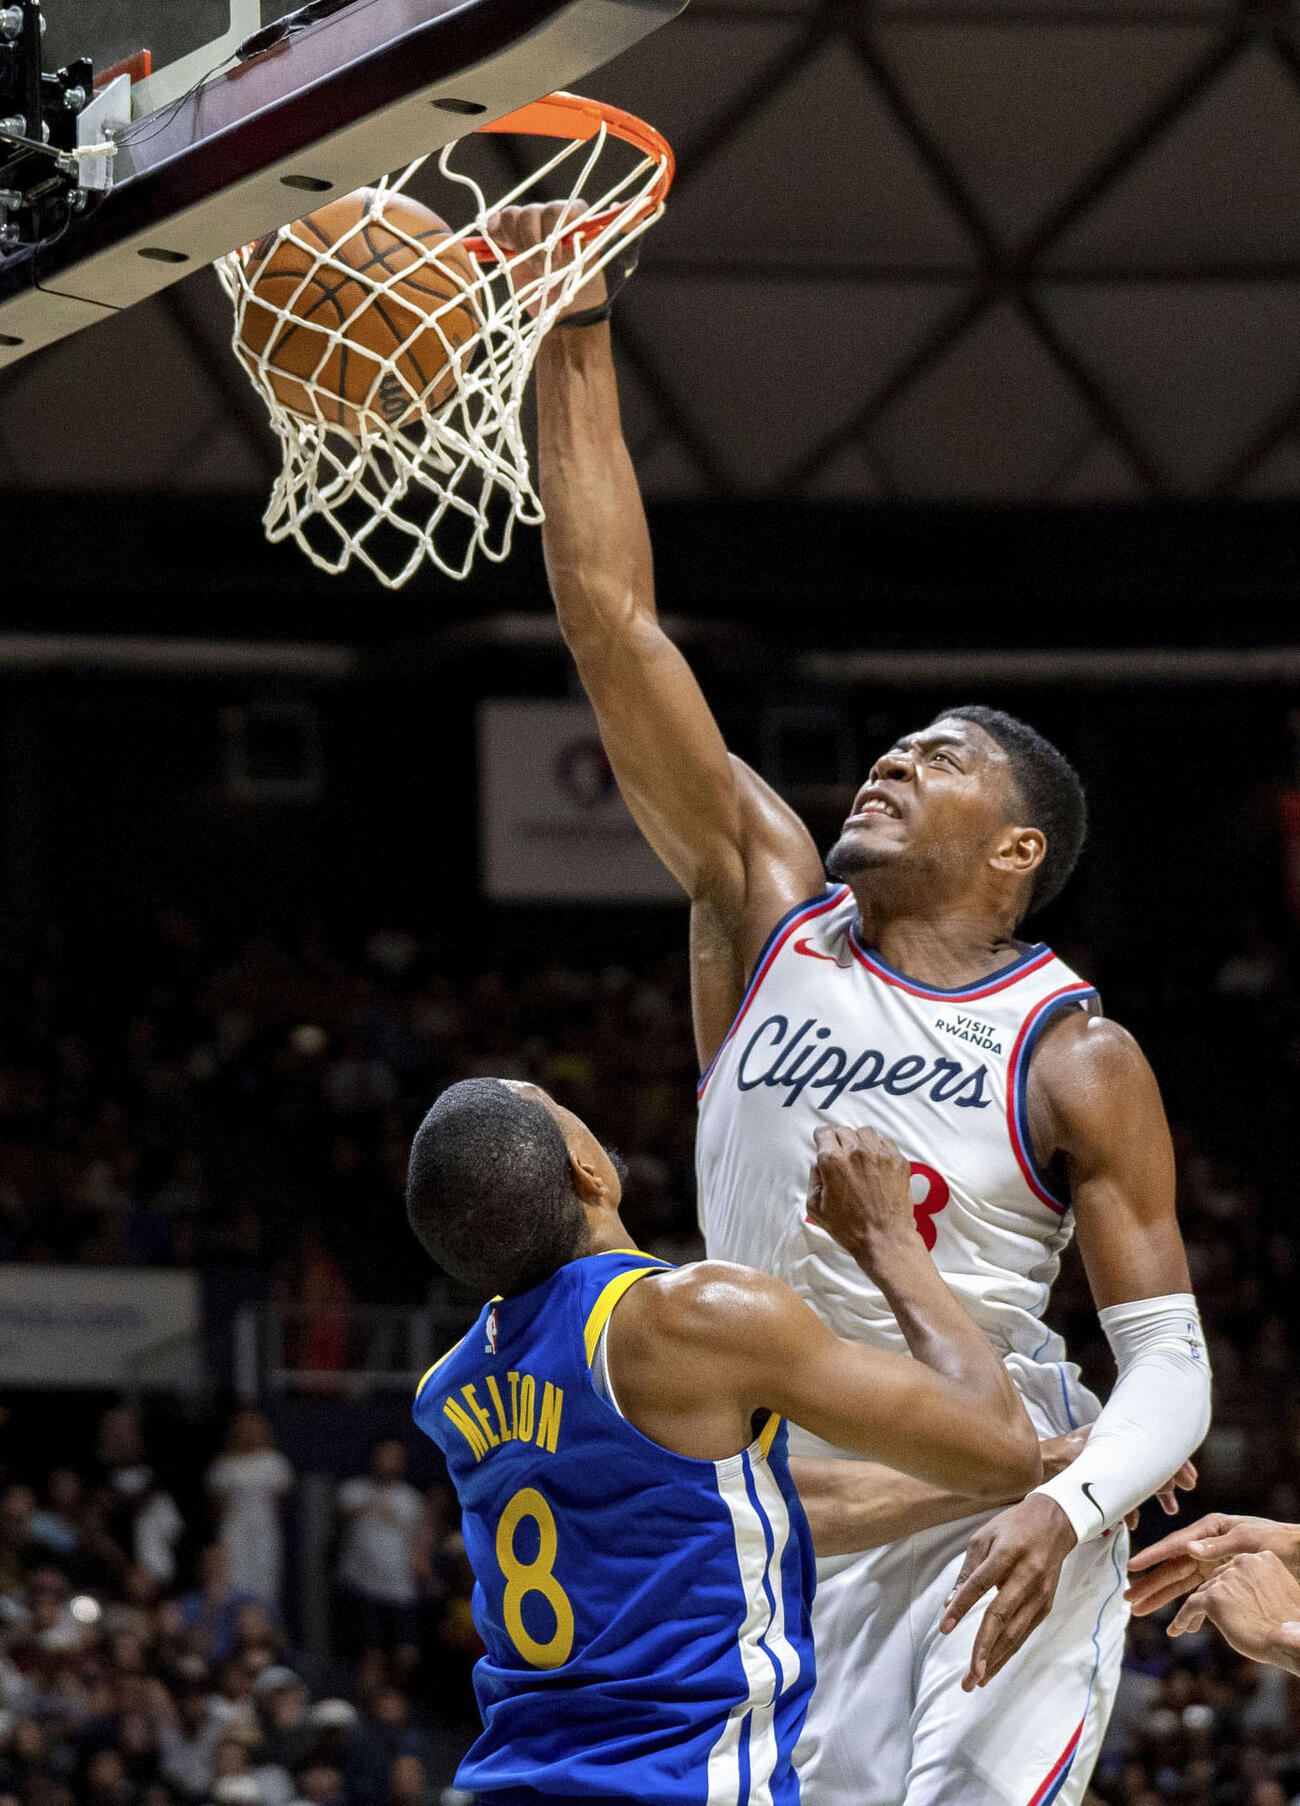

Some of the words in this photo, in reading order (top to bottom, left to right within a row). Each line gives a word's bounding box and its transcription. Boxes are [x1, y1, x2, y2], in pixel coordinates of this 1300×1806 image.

[738, 1014, 992, 1109] Clippers
[935, 1019, 1002, 1054] RWANDA
[957, 1015, 996, 1037] VISIT
[443, 1371, 564, 1462] MELTON
[496, 1487, 575, 1670] 8
